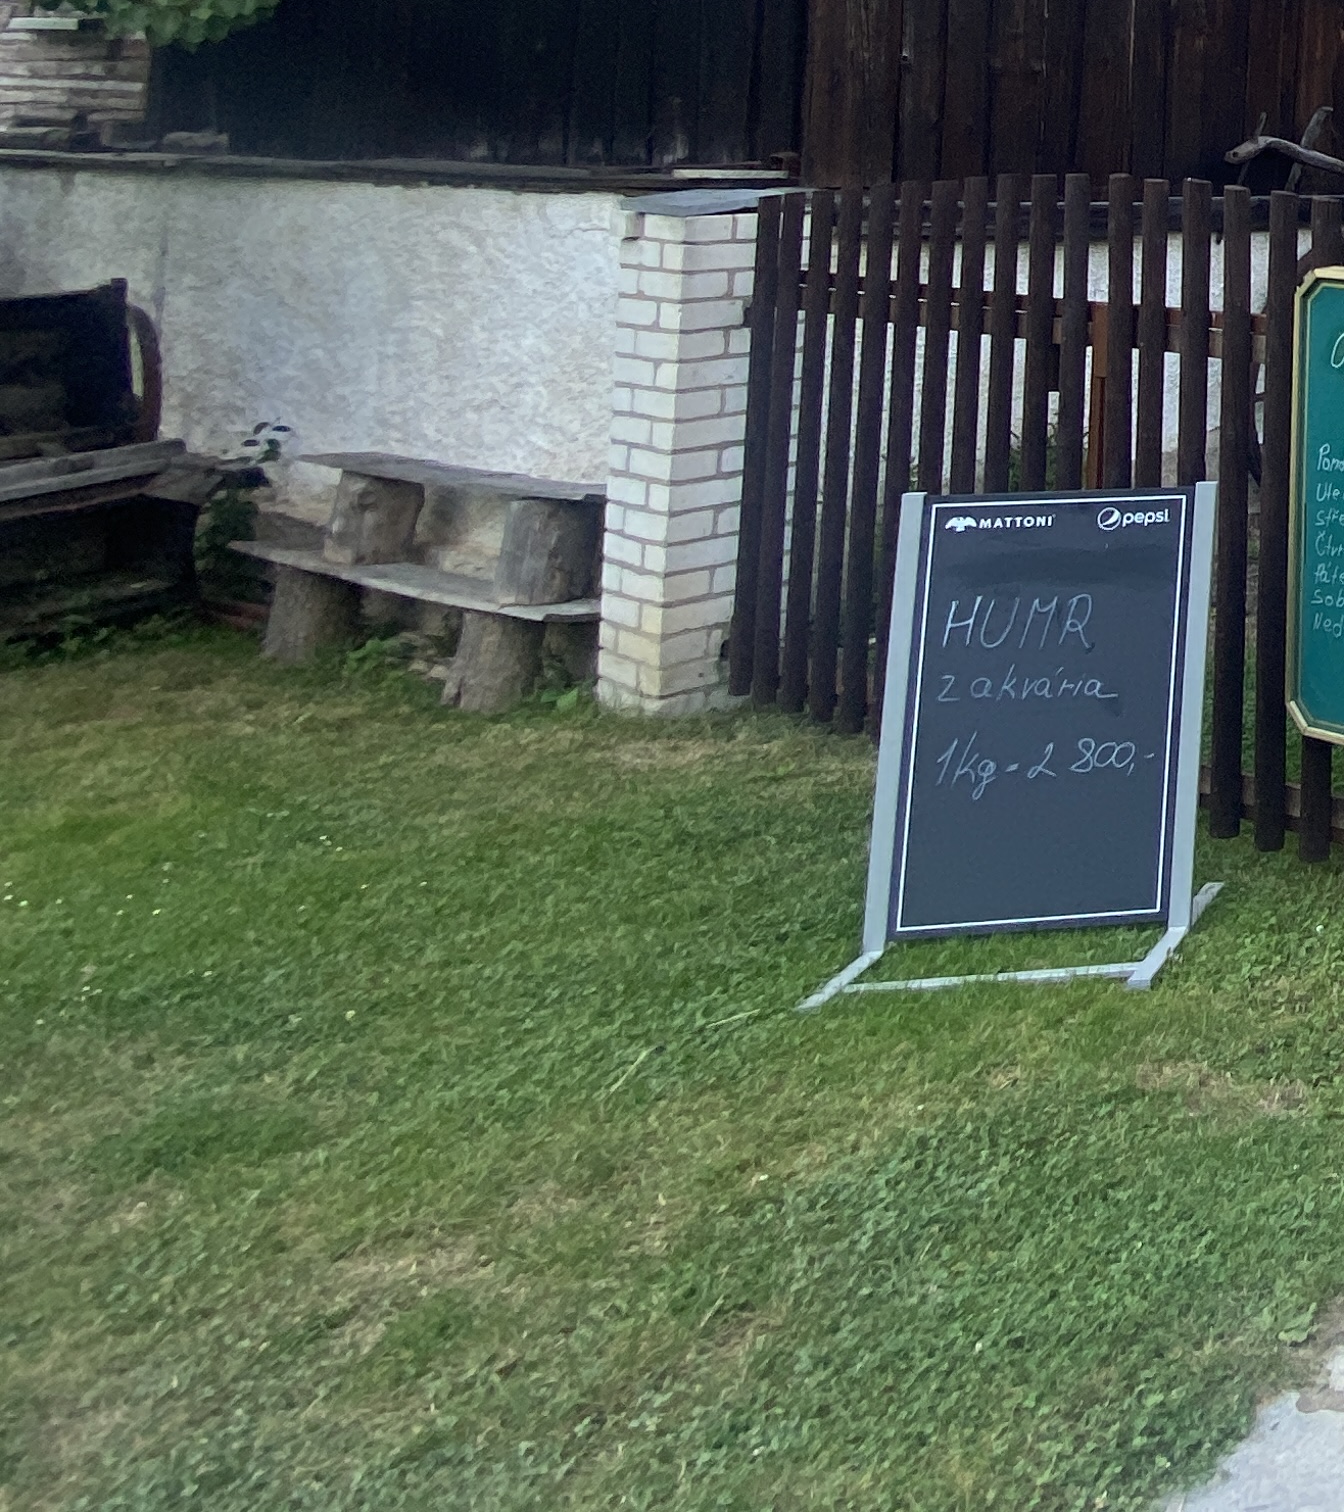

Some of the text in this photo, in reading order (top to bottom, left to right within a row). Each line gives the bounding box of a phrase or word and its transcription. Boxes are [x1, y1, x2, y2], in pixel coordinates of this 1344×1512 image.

[979, 508, 1170, 529] MATTONI pepsi
[941, 592, 1095, 650] HUMR
